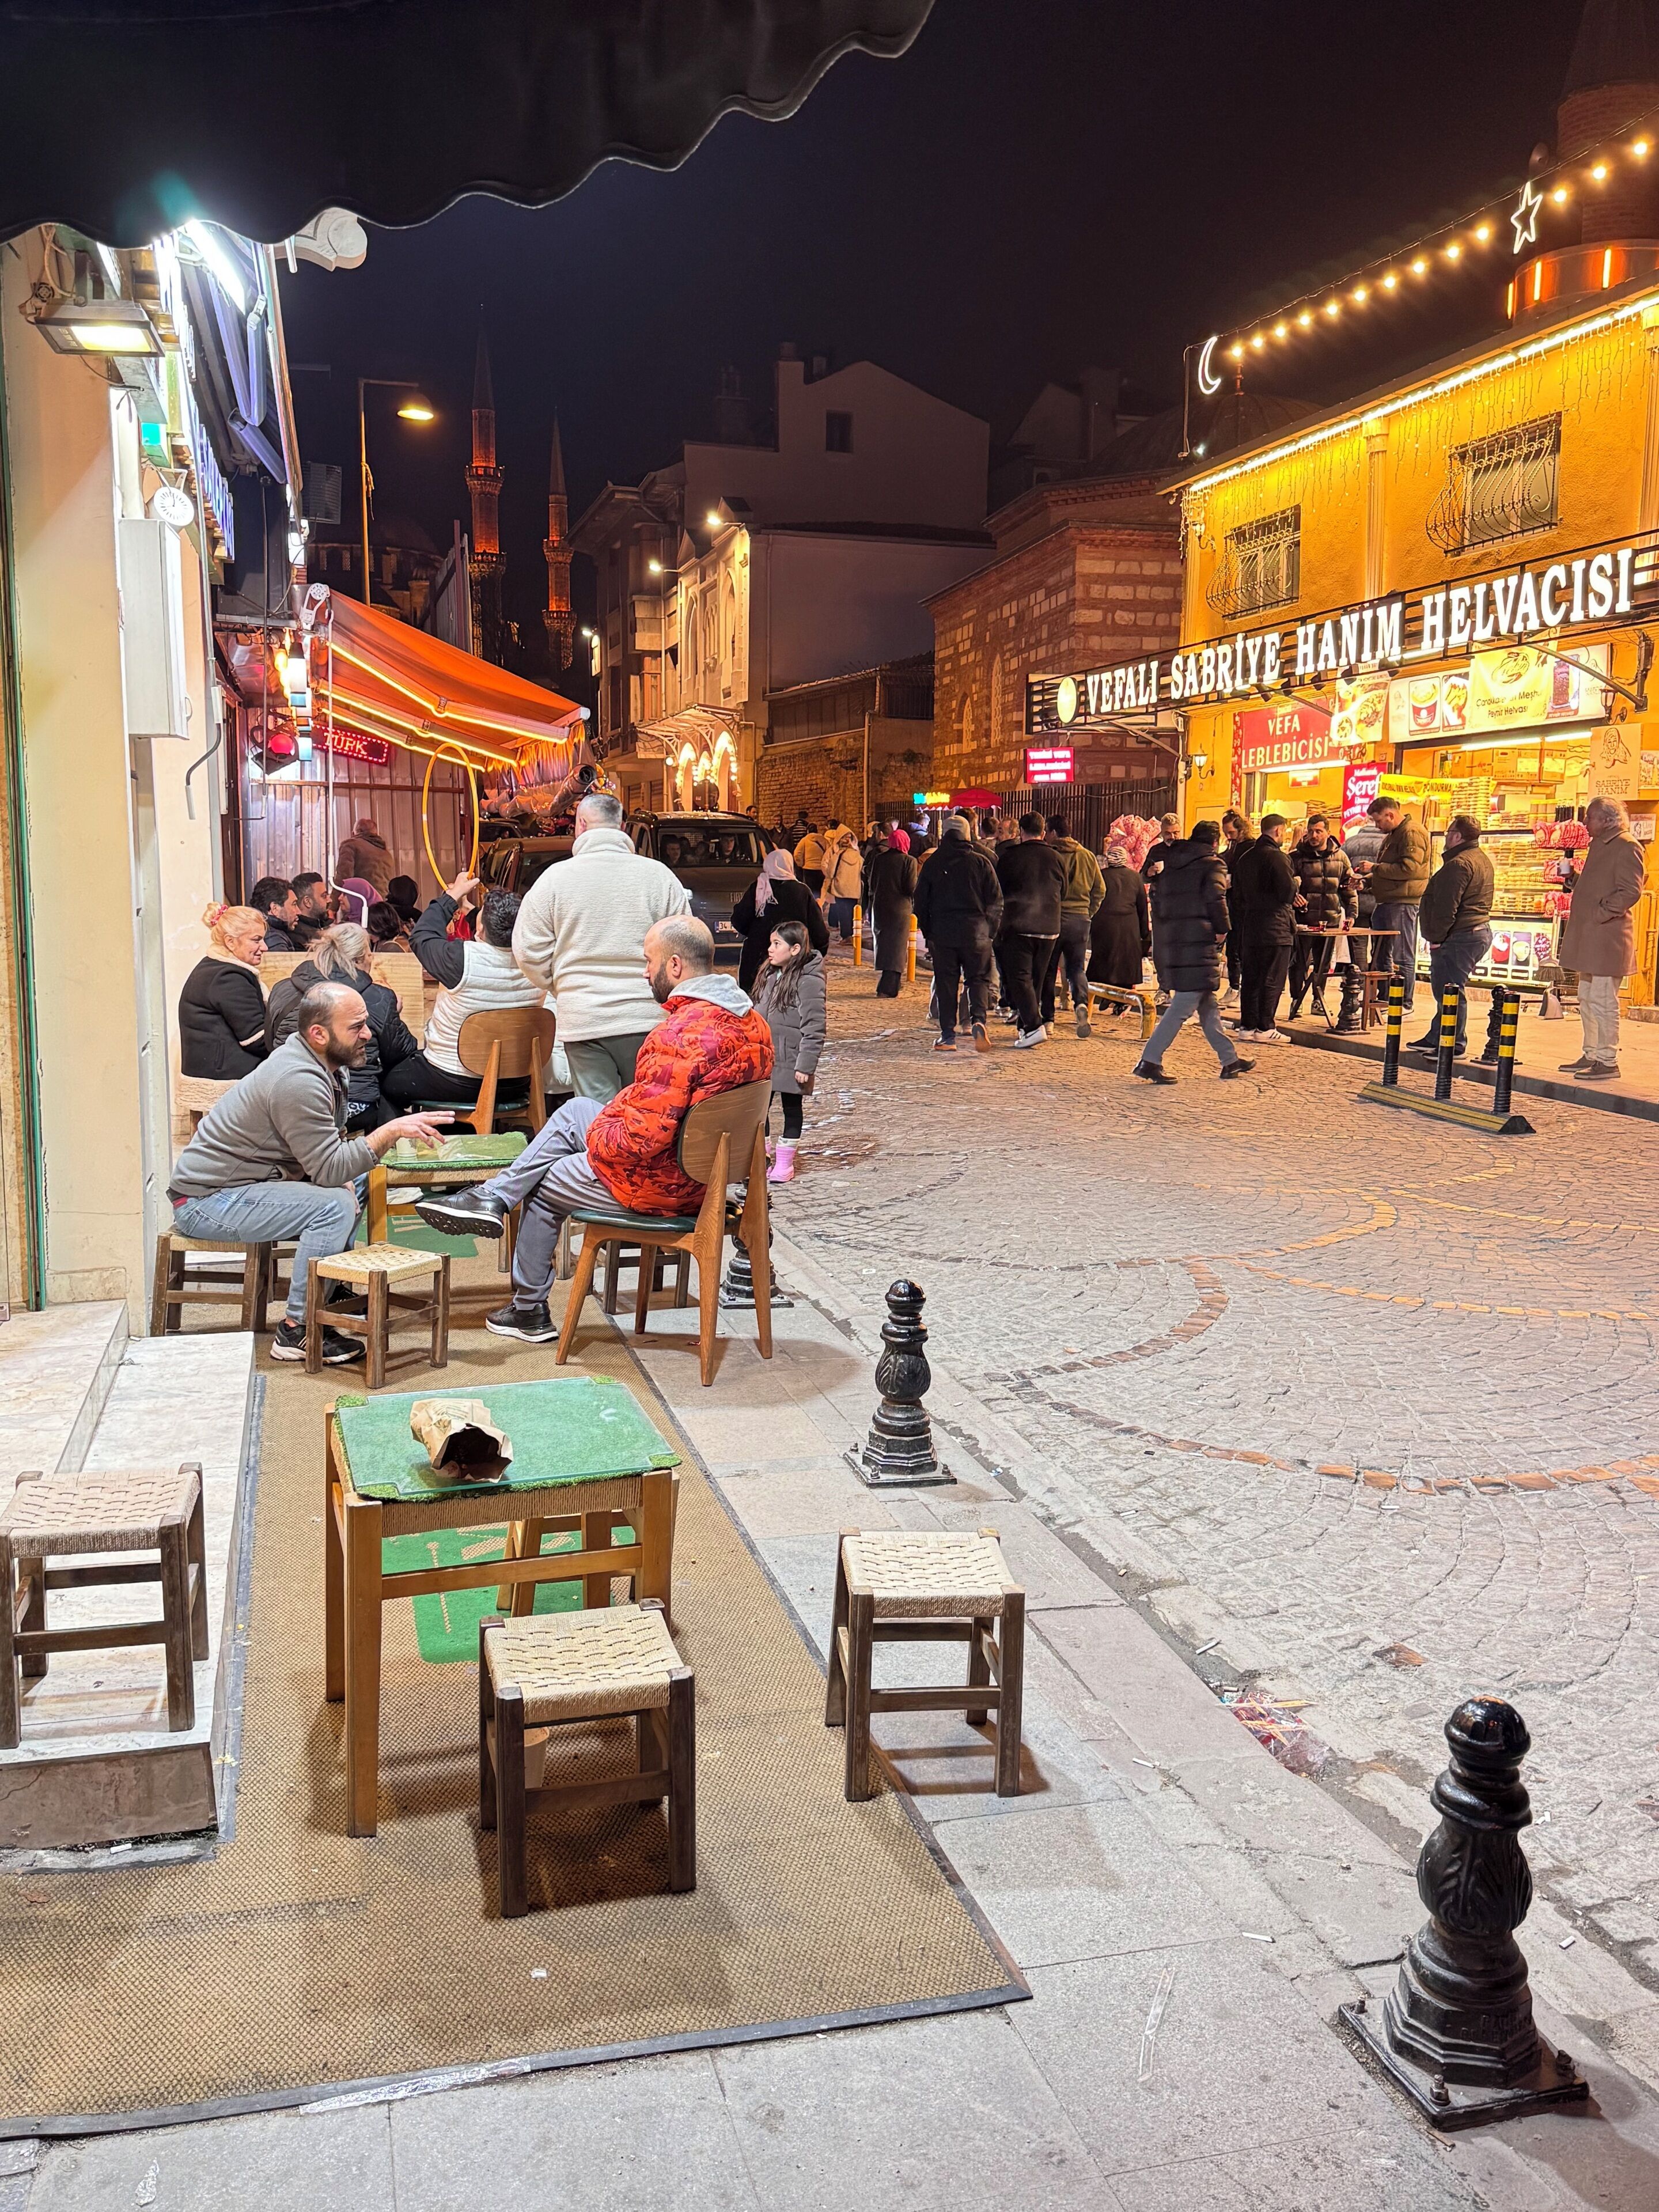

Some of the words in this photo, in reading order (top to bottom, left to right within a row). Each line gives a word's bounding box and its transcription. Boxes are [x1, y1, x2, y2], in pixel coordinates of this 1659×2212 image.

[1087, 660, 1158, 715] VEFALI
[1171, 632, 1281, 700] SABRİYE
[1296, 603, 1402, 676] HANIM
[1421, 548, 1634, 650] HELVACISI
[1268, 714, 1300, 736] VEFA
[324, 732, 368, 755] TÜRK
[1241, 730, 1329, 768] LEBLEBİCİSİ
